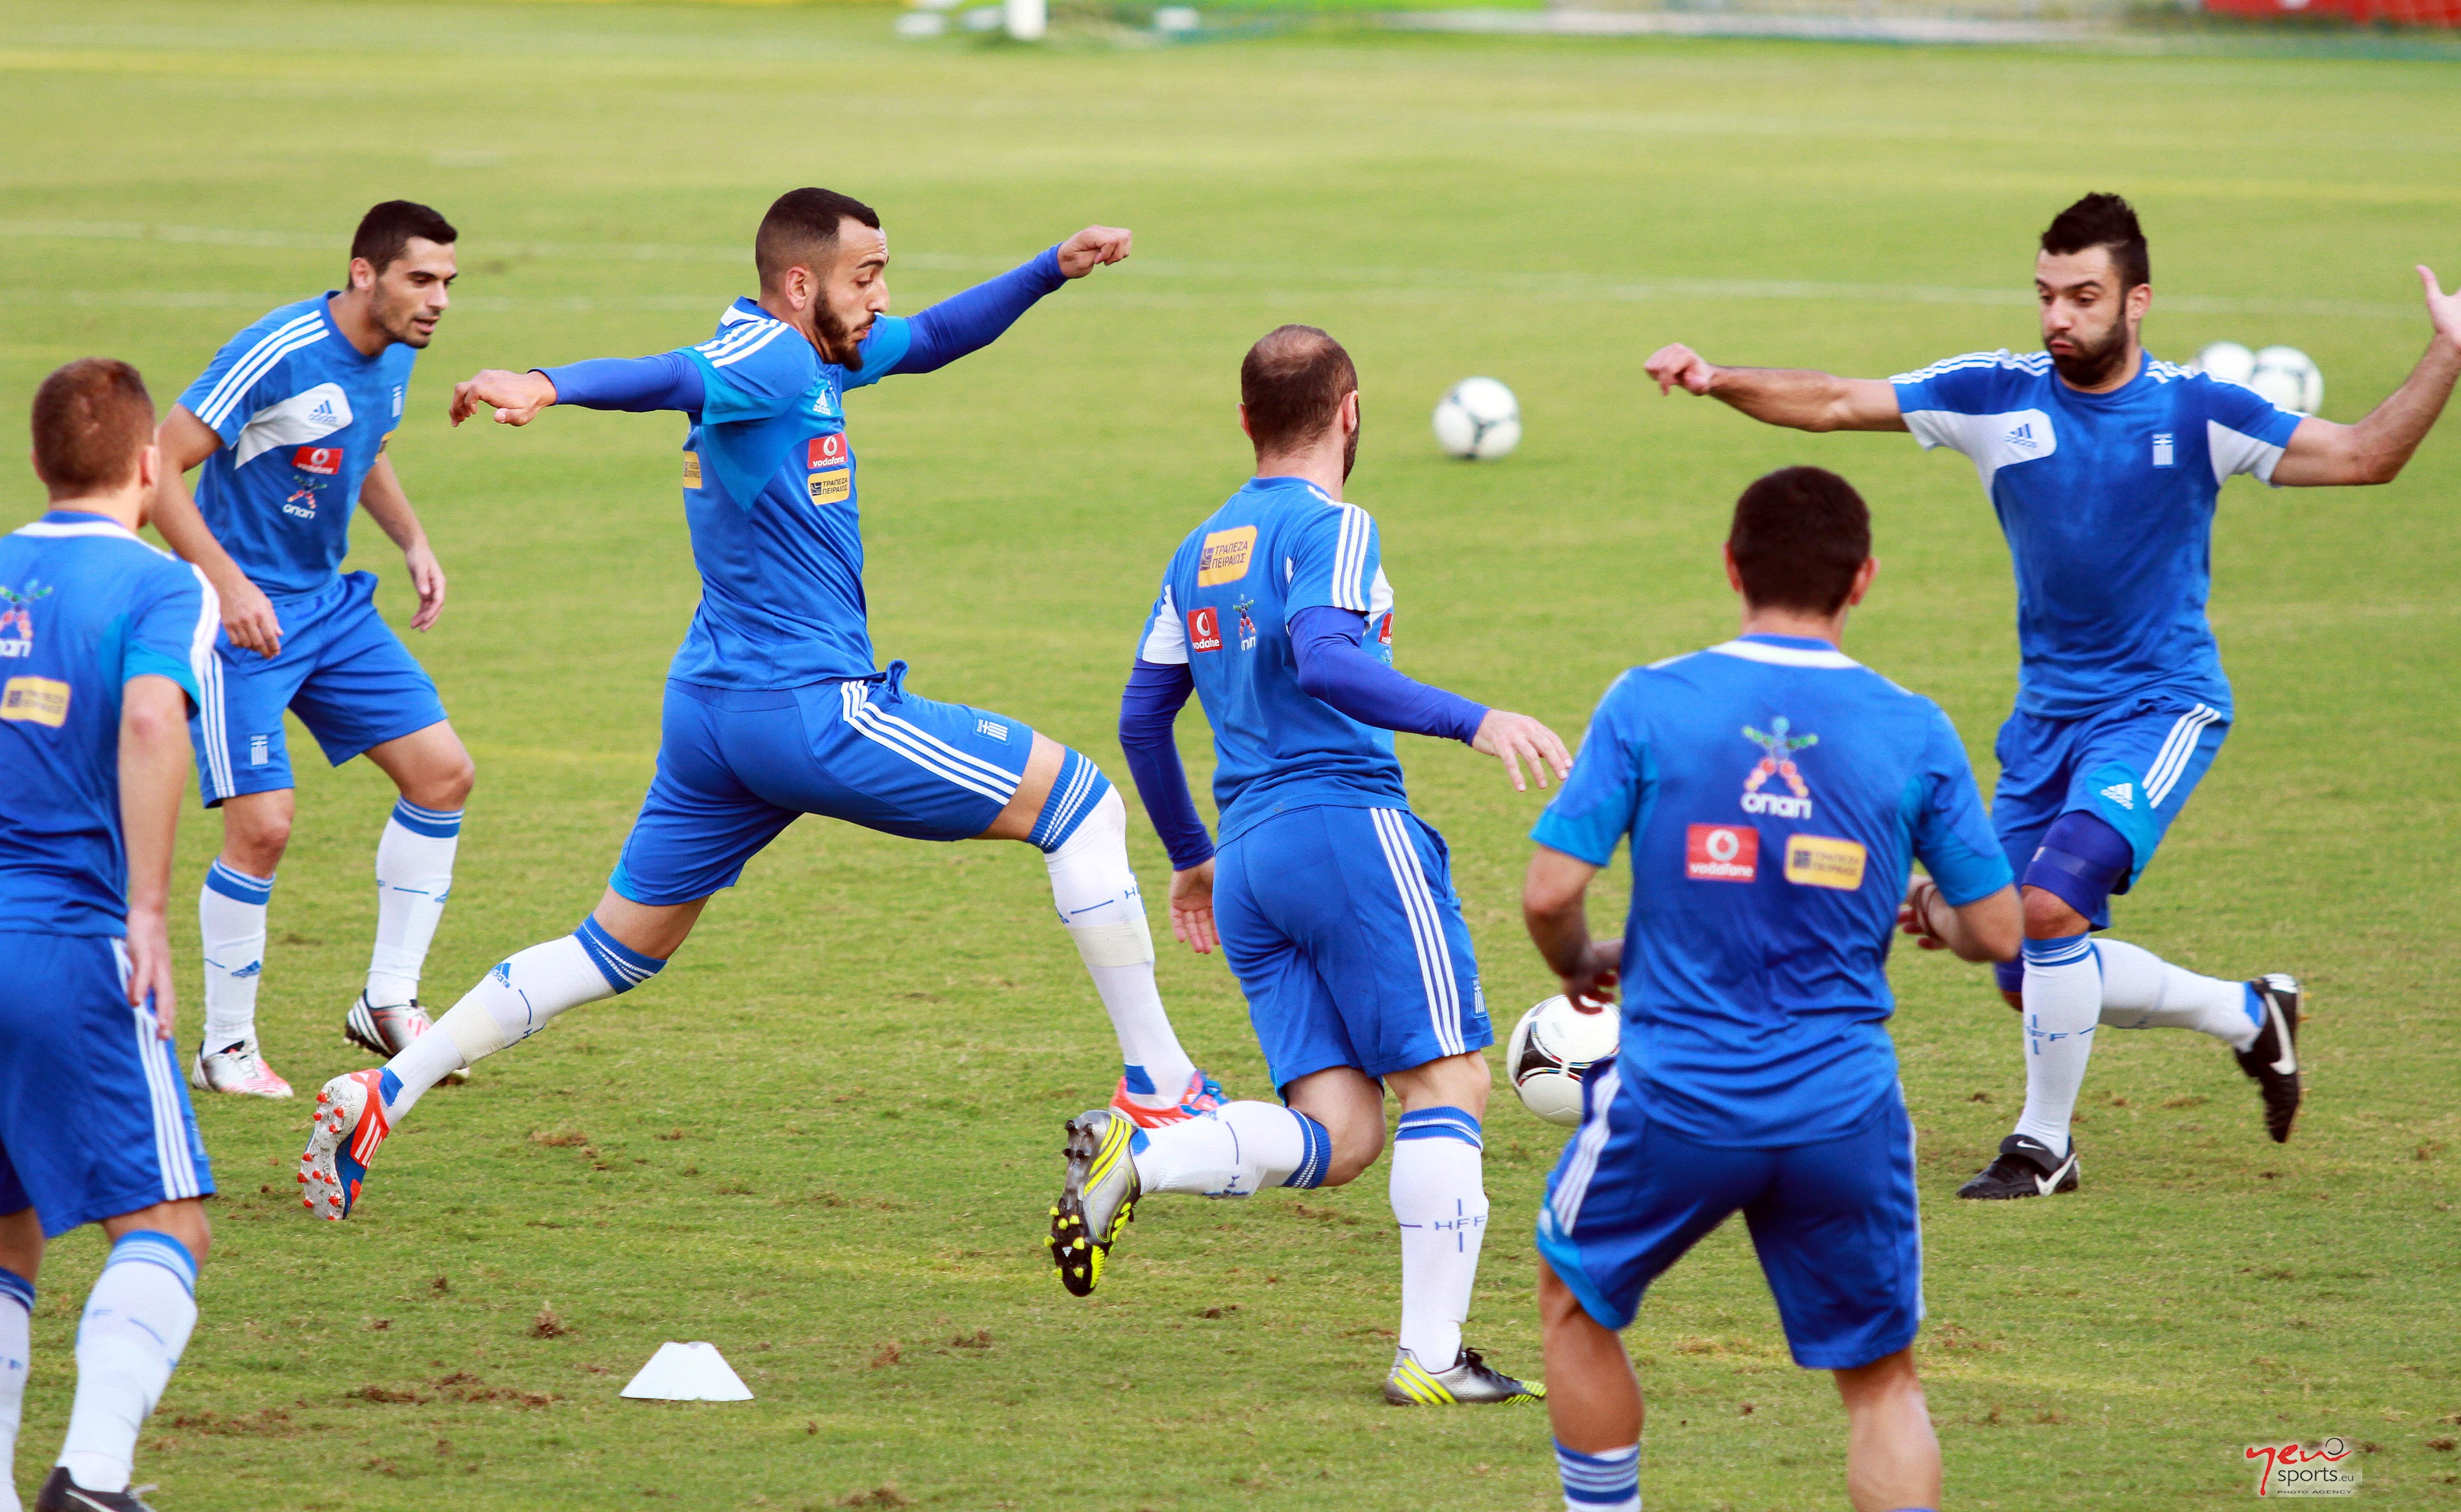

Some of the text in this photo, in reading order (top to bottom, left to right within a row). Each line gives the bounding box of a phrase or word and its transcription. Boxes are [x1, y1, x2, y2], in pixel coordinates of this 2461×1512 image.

[812, 456, 845, 467] vodafone
[822, 477, 848, 487] ΤΡΑΠΕΖΑ
[1215, 541, 1248, 555] ΤΡΑΠΕΖΑ
